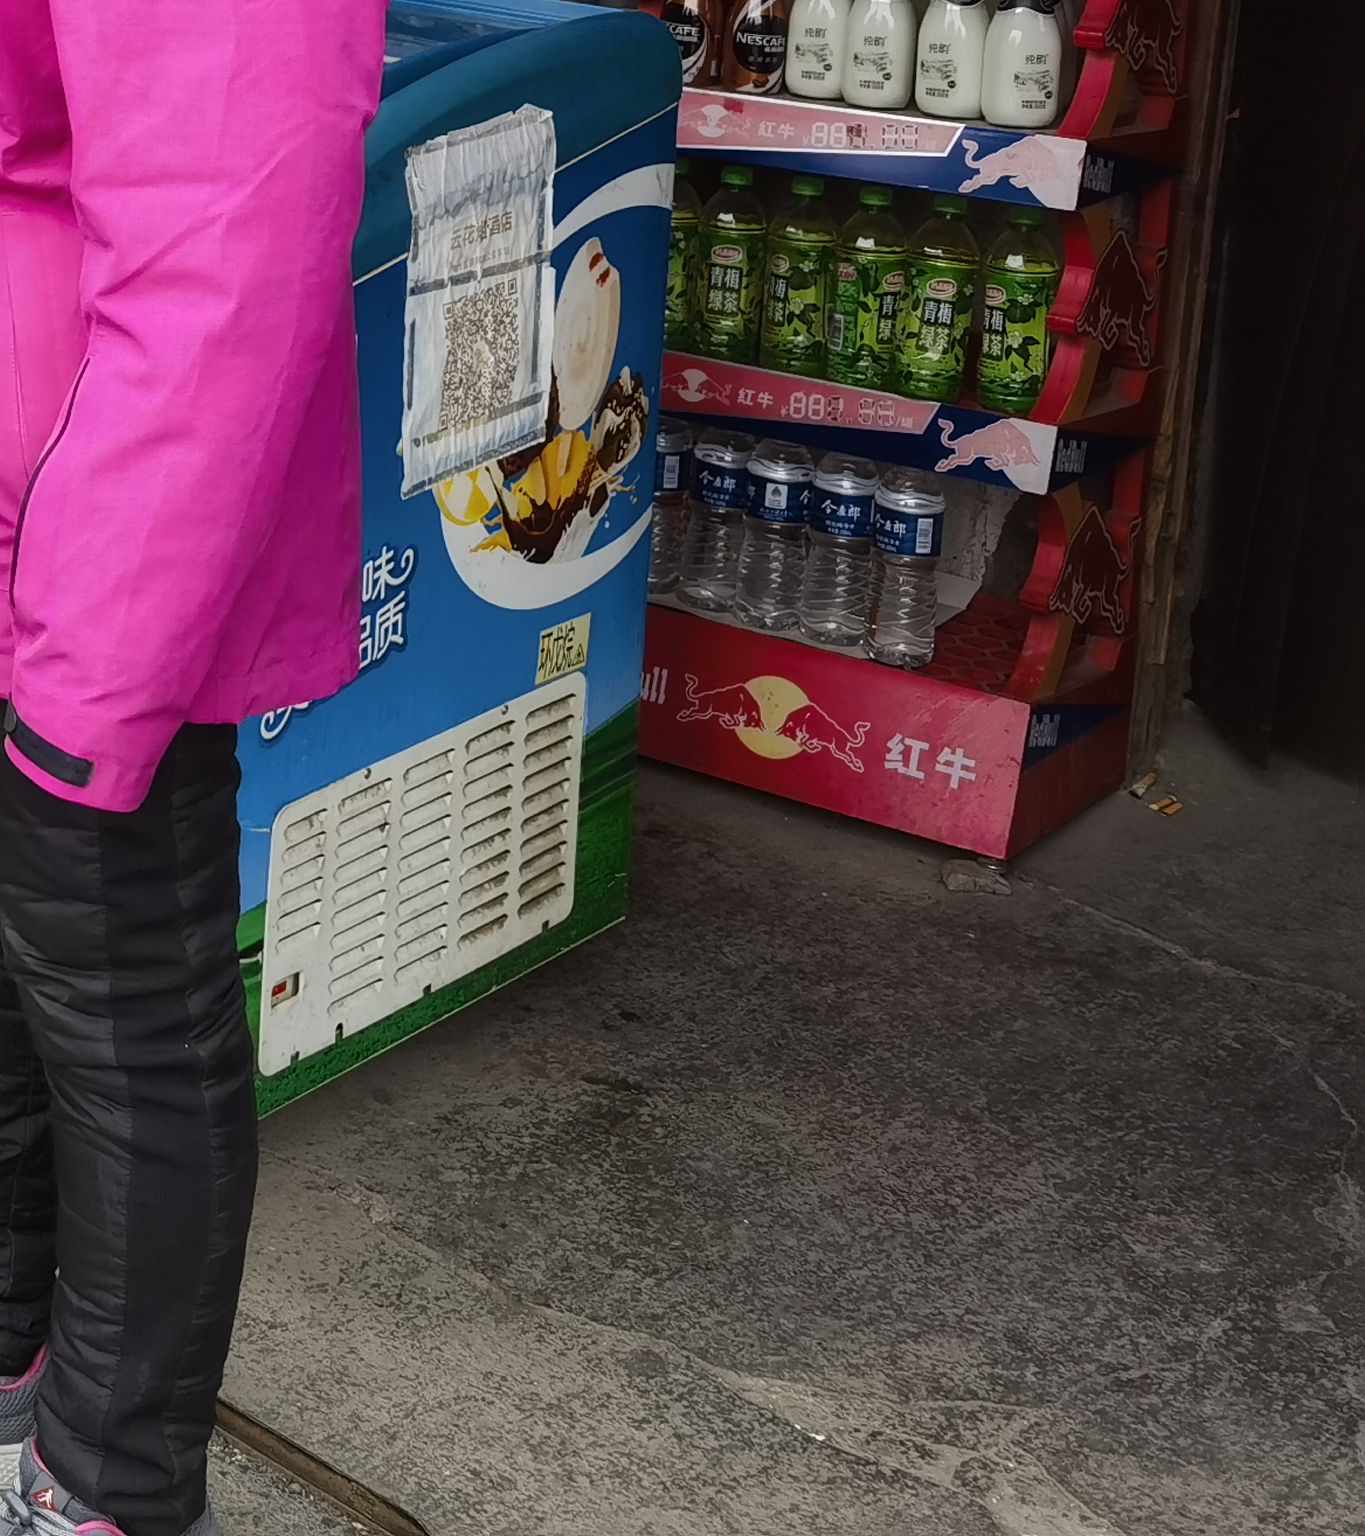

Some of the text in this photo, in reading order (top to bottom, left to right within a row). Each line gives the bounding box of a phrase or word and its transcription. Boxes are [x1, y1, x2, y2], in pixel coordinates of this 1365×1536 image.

[756, 119, 796, 141] 红牛
[735, 386, 775, 410] 红牛
[884, 732, 977, 790] 红牛
